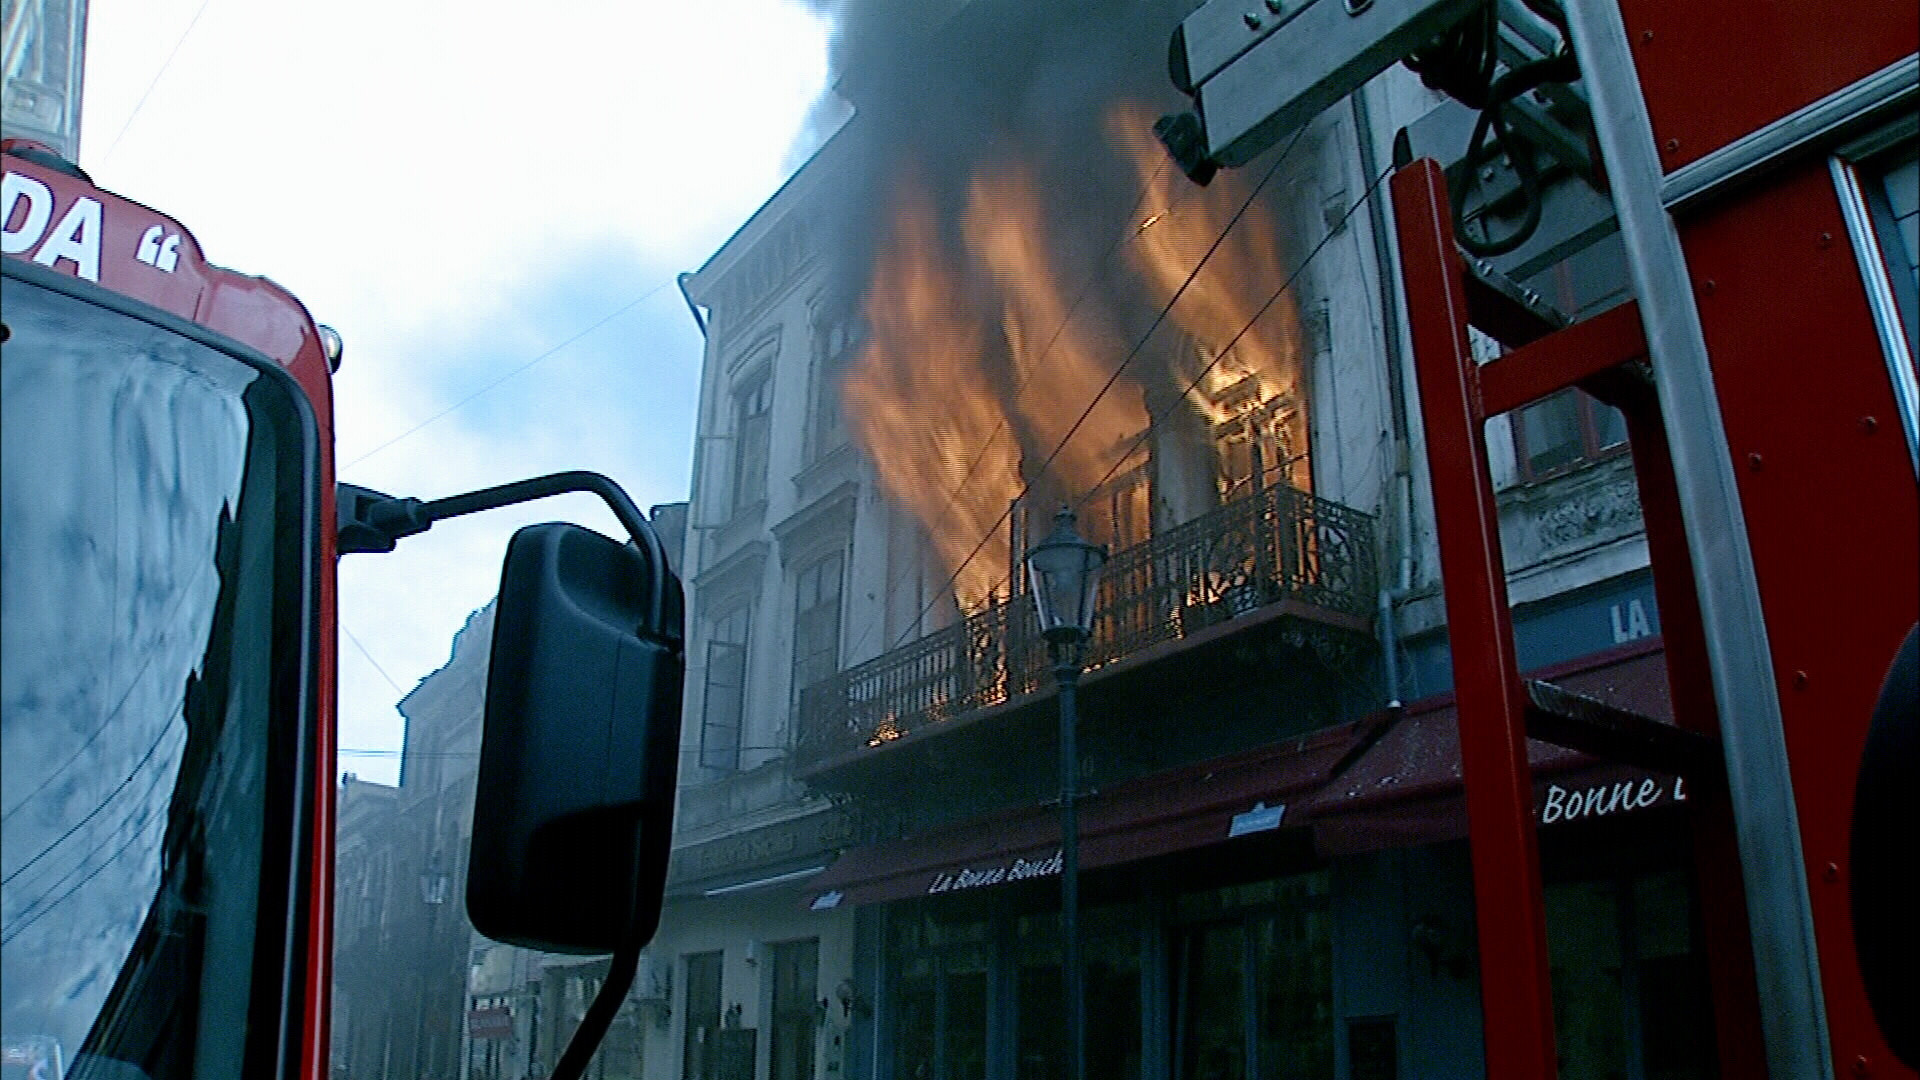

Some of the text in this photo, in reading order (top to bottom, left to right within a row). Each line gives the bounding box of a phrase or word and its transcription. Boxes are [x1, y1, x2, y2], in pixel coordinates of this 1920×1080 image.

[1610, 599, 1650, 644] LA
[1542, 776, 1662, 824] Bonne
[928, 849, 1064, 894] La Bonne Bouch
